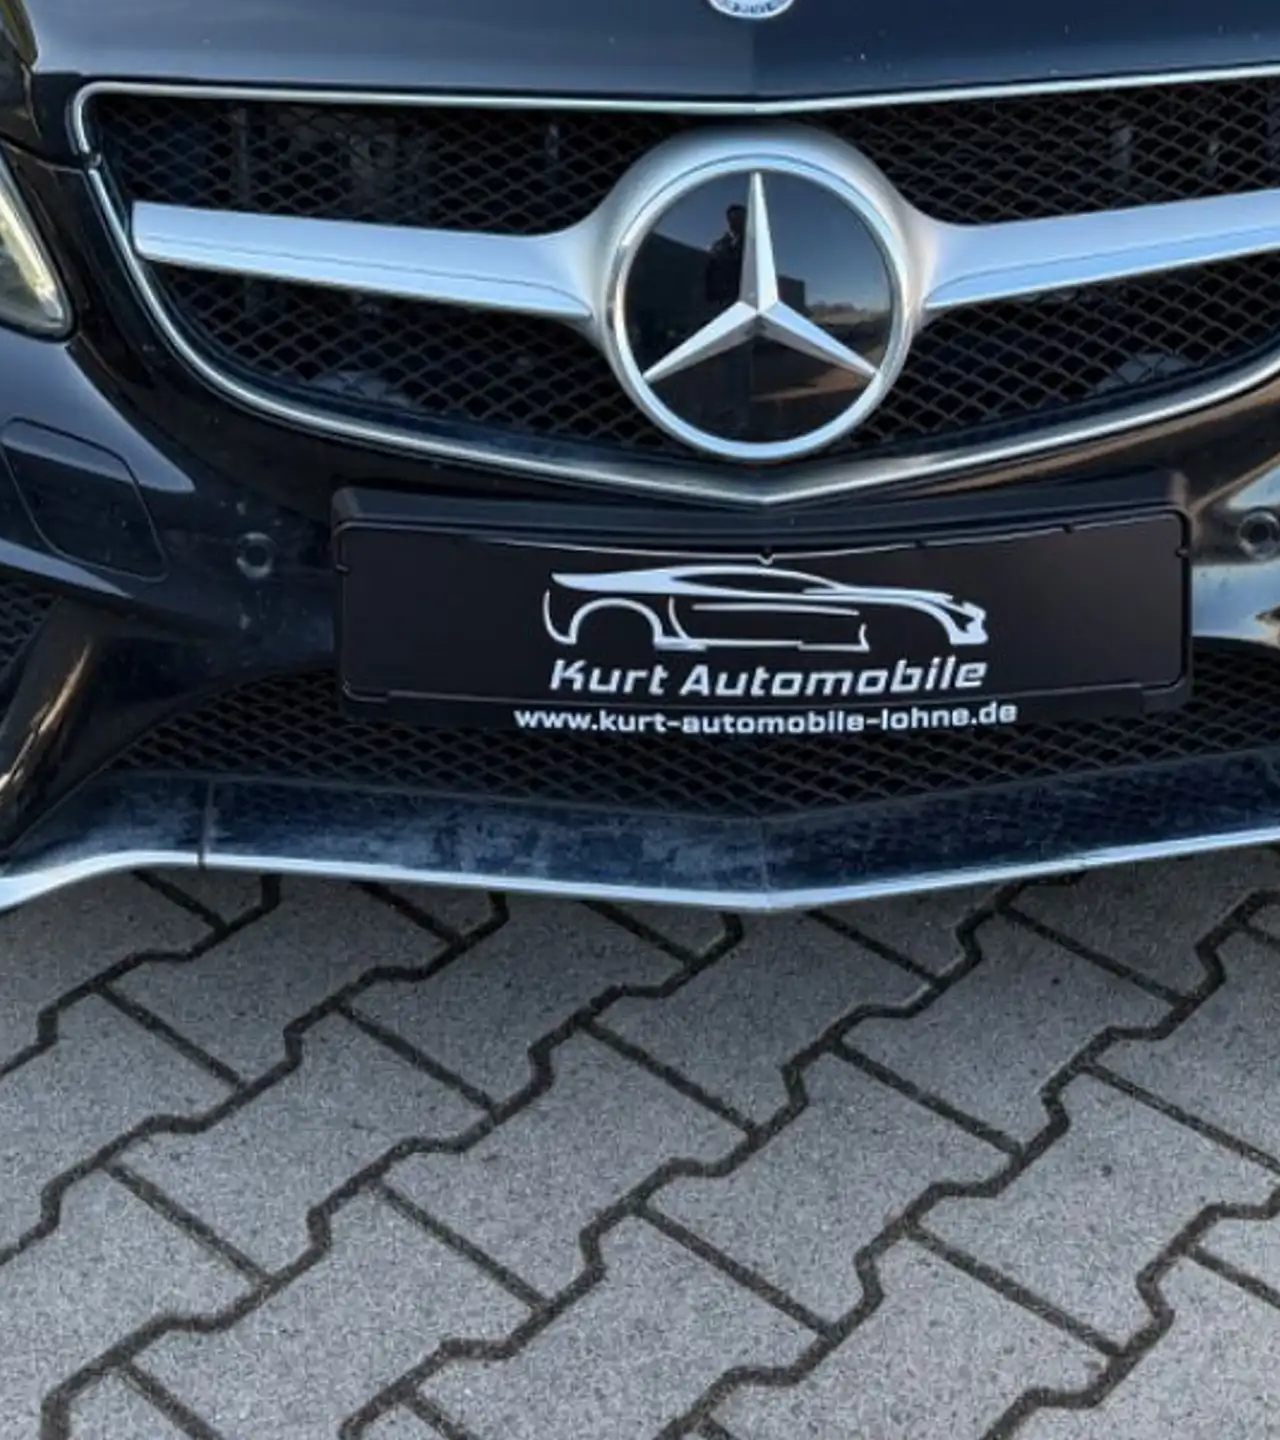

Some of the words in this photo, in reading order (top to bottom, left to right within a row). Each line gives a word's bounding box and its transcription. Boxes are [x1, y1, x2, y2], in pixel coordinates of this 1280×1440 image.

[549, 658, 669, 696] Kurt
[678, 655, 988, 697] Automobile
[513, 701, 1017, 734] www.kurt-automobile-lohne.de
